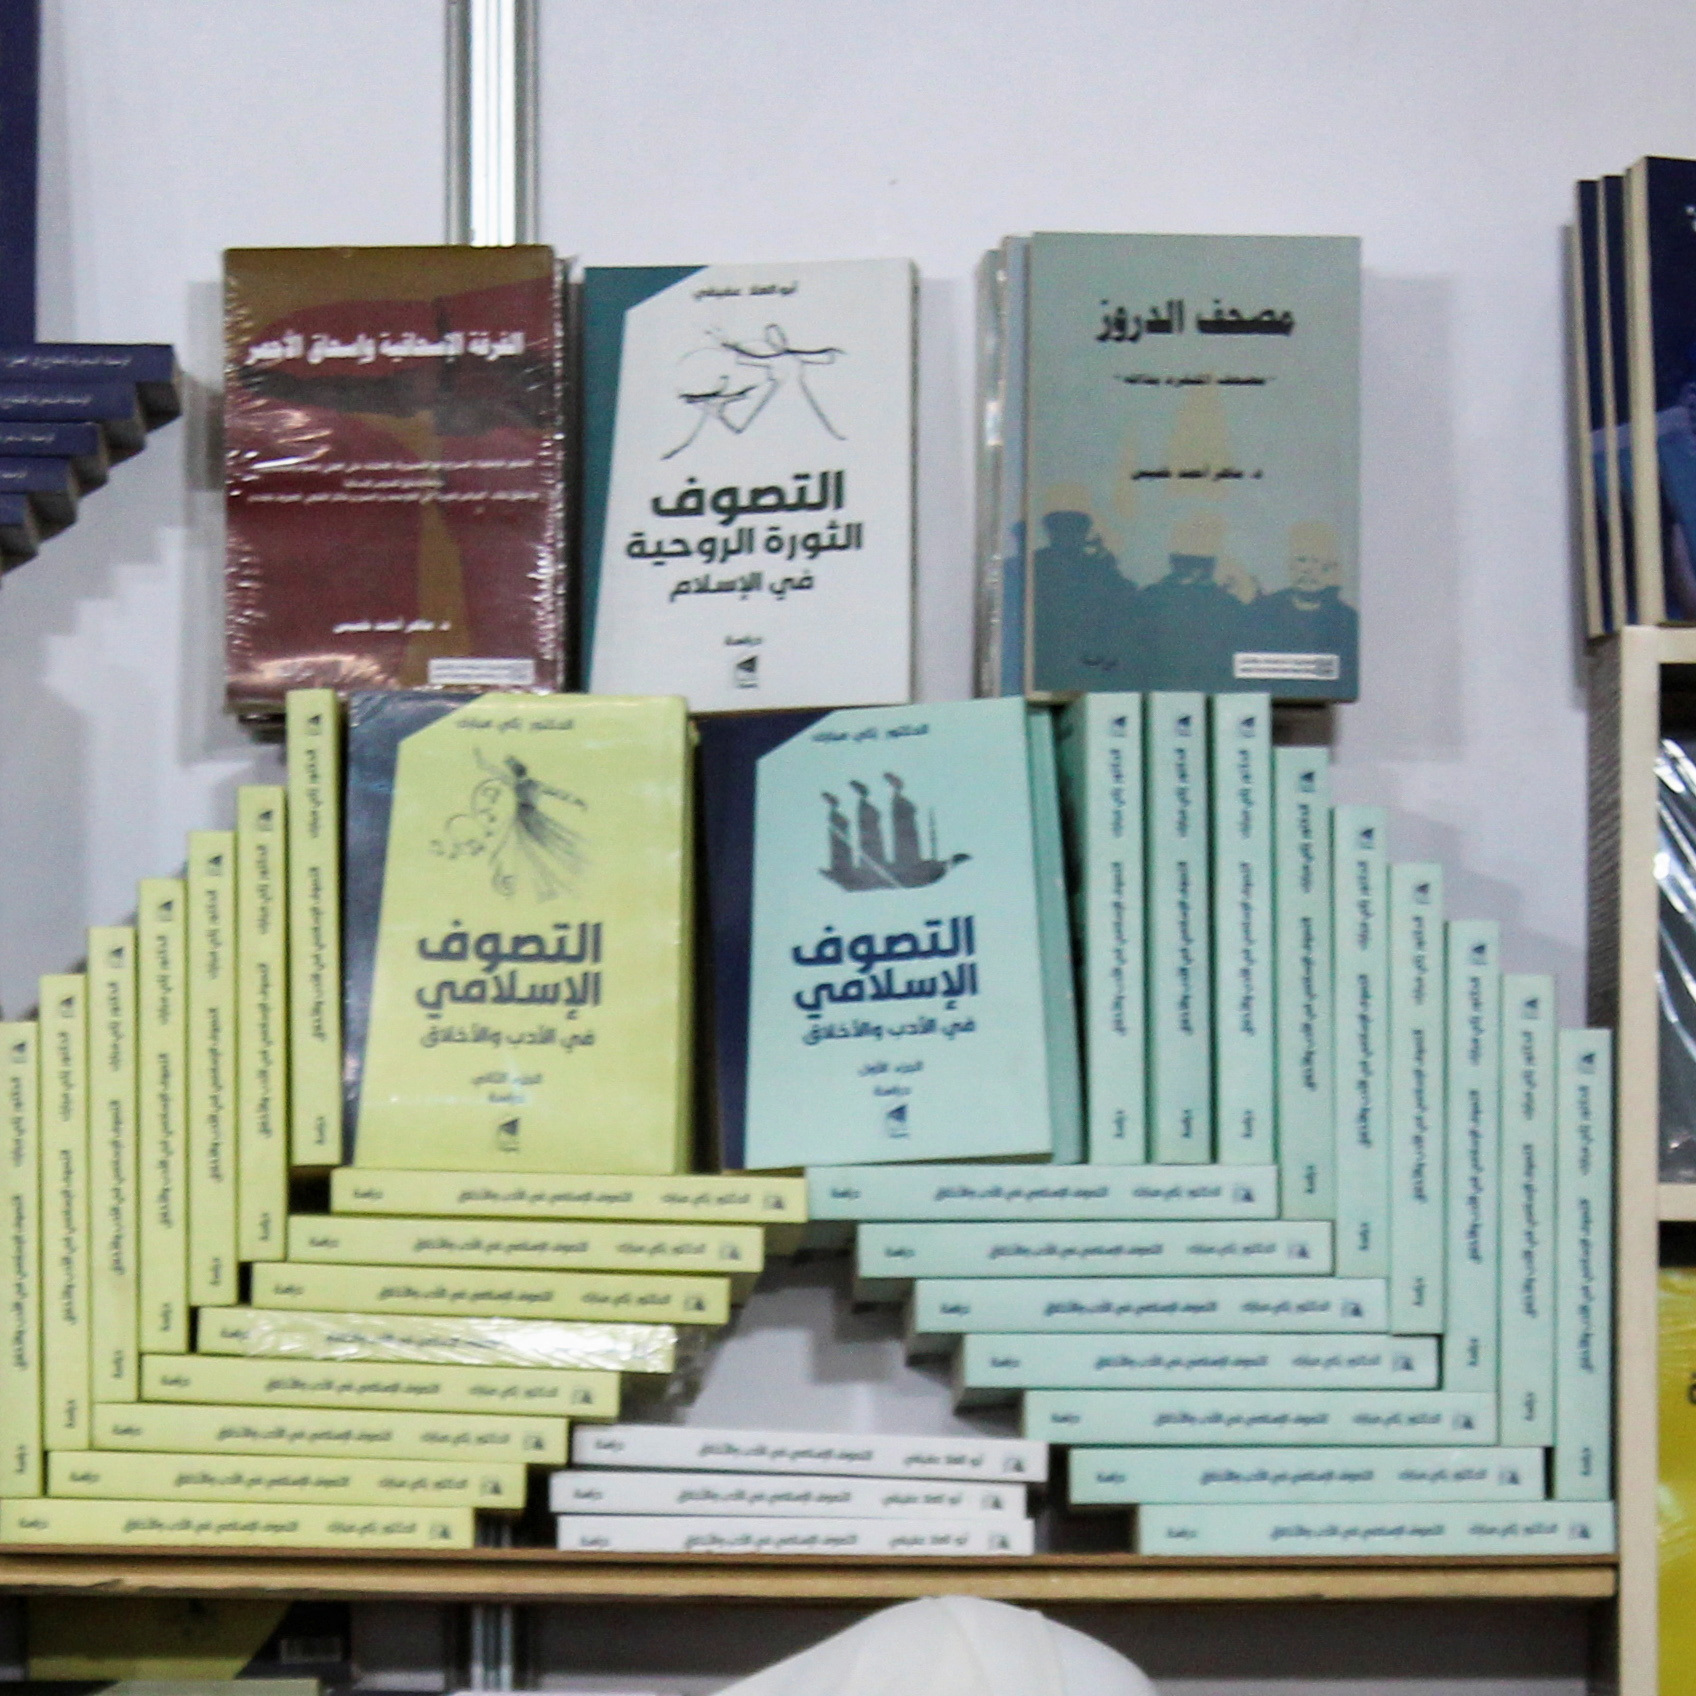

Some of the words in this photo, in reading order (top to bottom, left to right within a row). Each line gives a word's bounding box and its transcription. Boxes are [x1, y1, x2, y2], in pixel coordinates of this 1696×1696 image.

[1097, 300, 1184, 342] الدروز
[1197, 301, 1295, 335] مصحف
[651, 472, 846, 518] التصوف
[625, 526, 754, 566] الروحية
[766, 523, 862, 556] الثورة
[670, 571, 763, 602] الإسلام
[769, 571, 815, 601] في
[417, 918, 603, 973] التصوف
[791, 915, 975, 974] التصوف
[416, 971, 603, 1022] الإسلامي
[794, 964, 979, 1020] الإسلامي
[421, 1023, 501, 1049] والأخلاق
[506, 1025, 557, 1046] الأدب
[561, 1028, 596, 1053] في
[802, 1022, 883, 1047] والأخلاق
[889, 1016, 937, 1040] الأدب
[940, 1017, 976, 1041] في
